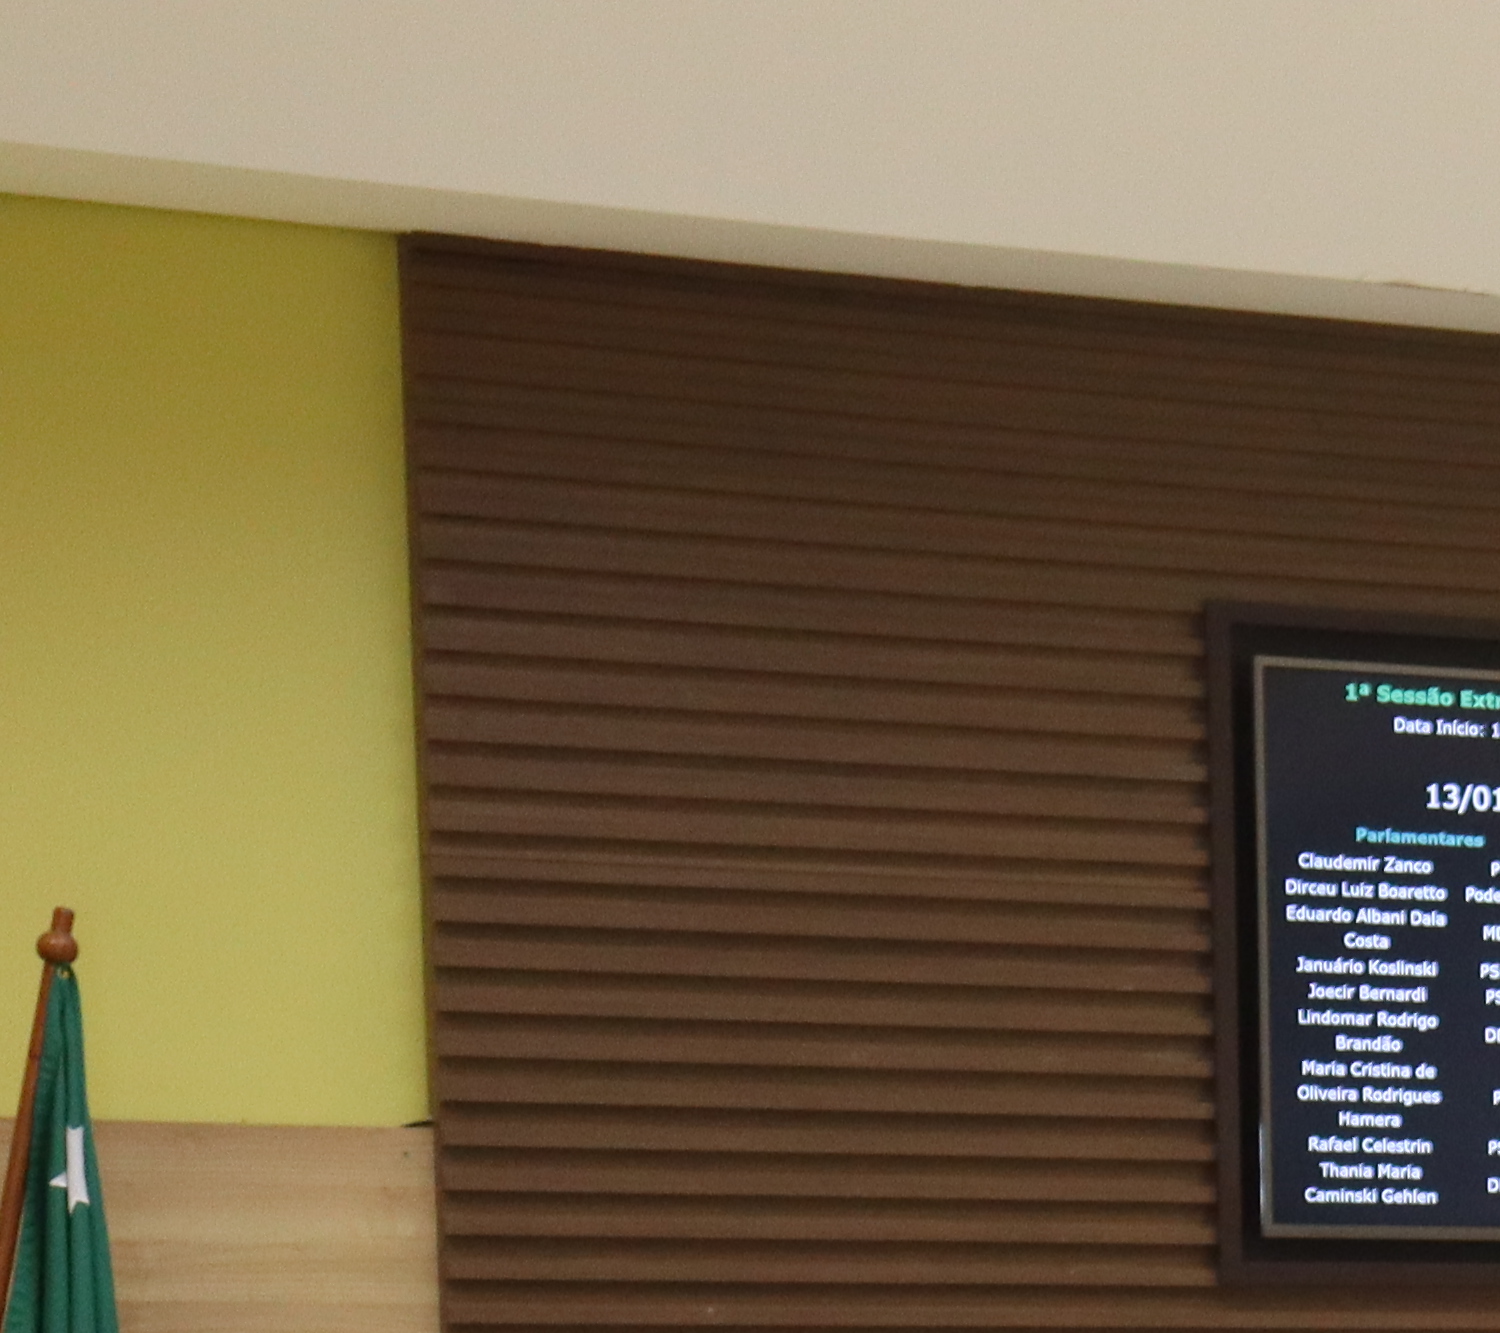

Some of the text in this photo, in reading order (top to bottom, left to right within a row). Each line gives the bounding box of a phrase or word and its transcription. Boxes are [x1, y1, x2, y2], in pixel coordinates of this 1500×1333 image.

[1346, 683, 1371, 701] 1ª
[1377, 684, 1455, 707] Sessão
[1394, 716, 1434, 735] Data
[1436, 718, 1487, 737] Início:
[1356, 826, 1486, 848] Parlamentares
[1298, 851, 1434, 874] Claudemir Zanco
[1285, 877, 1448, 901] Dirceu Luiz Boaretto
[1286, 904, 1448, 927] Eduardo Albani Dala
[1344, 931, 1391, 950] Costa
[1296, 956, 1439, 977] Januário Koslinski
[1308, 982, 1428, 1003] Joecir Bernardi
[1298, 1009, 1440, 1032] Lindomar Rodrigo
[1335, 1033, 1404, 1052] Brandão
[1302, 1059, 1438, 1079] Maria Cristina de
[1297, 1084, 1443, 1107] Oliveira Rodrigues
[1339, 1110, 1403, 1128] Hamera
[1308, 1135, 1434, 1154] Rafael Celestrin
[1319, 1161, 1424, 1180] Thania Maria
[1305, 1186, 1439, 1205] Caminski Gehlen
